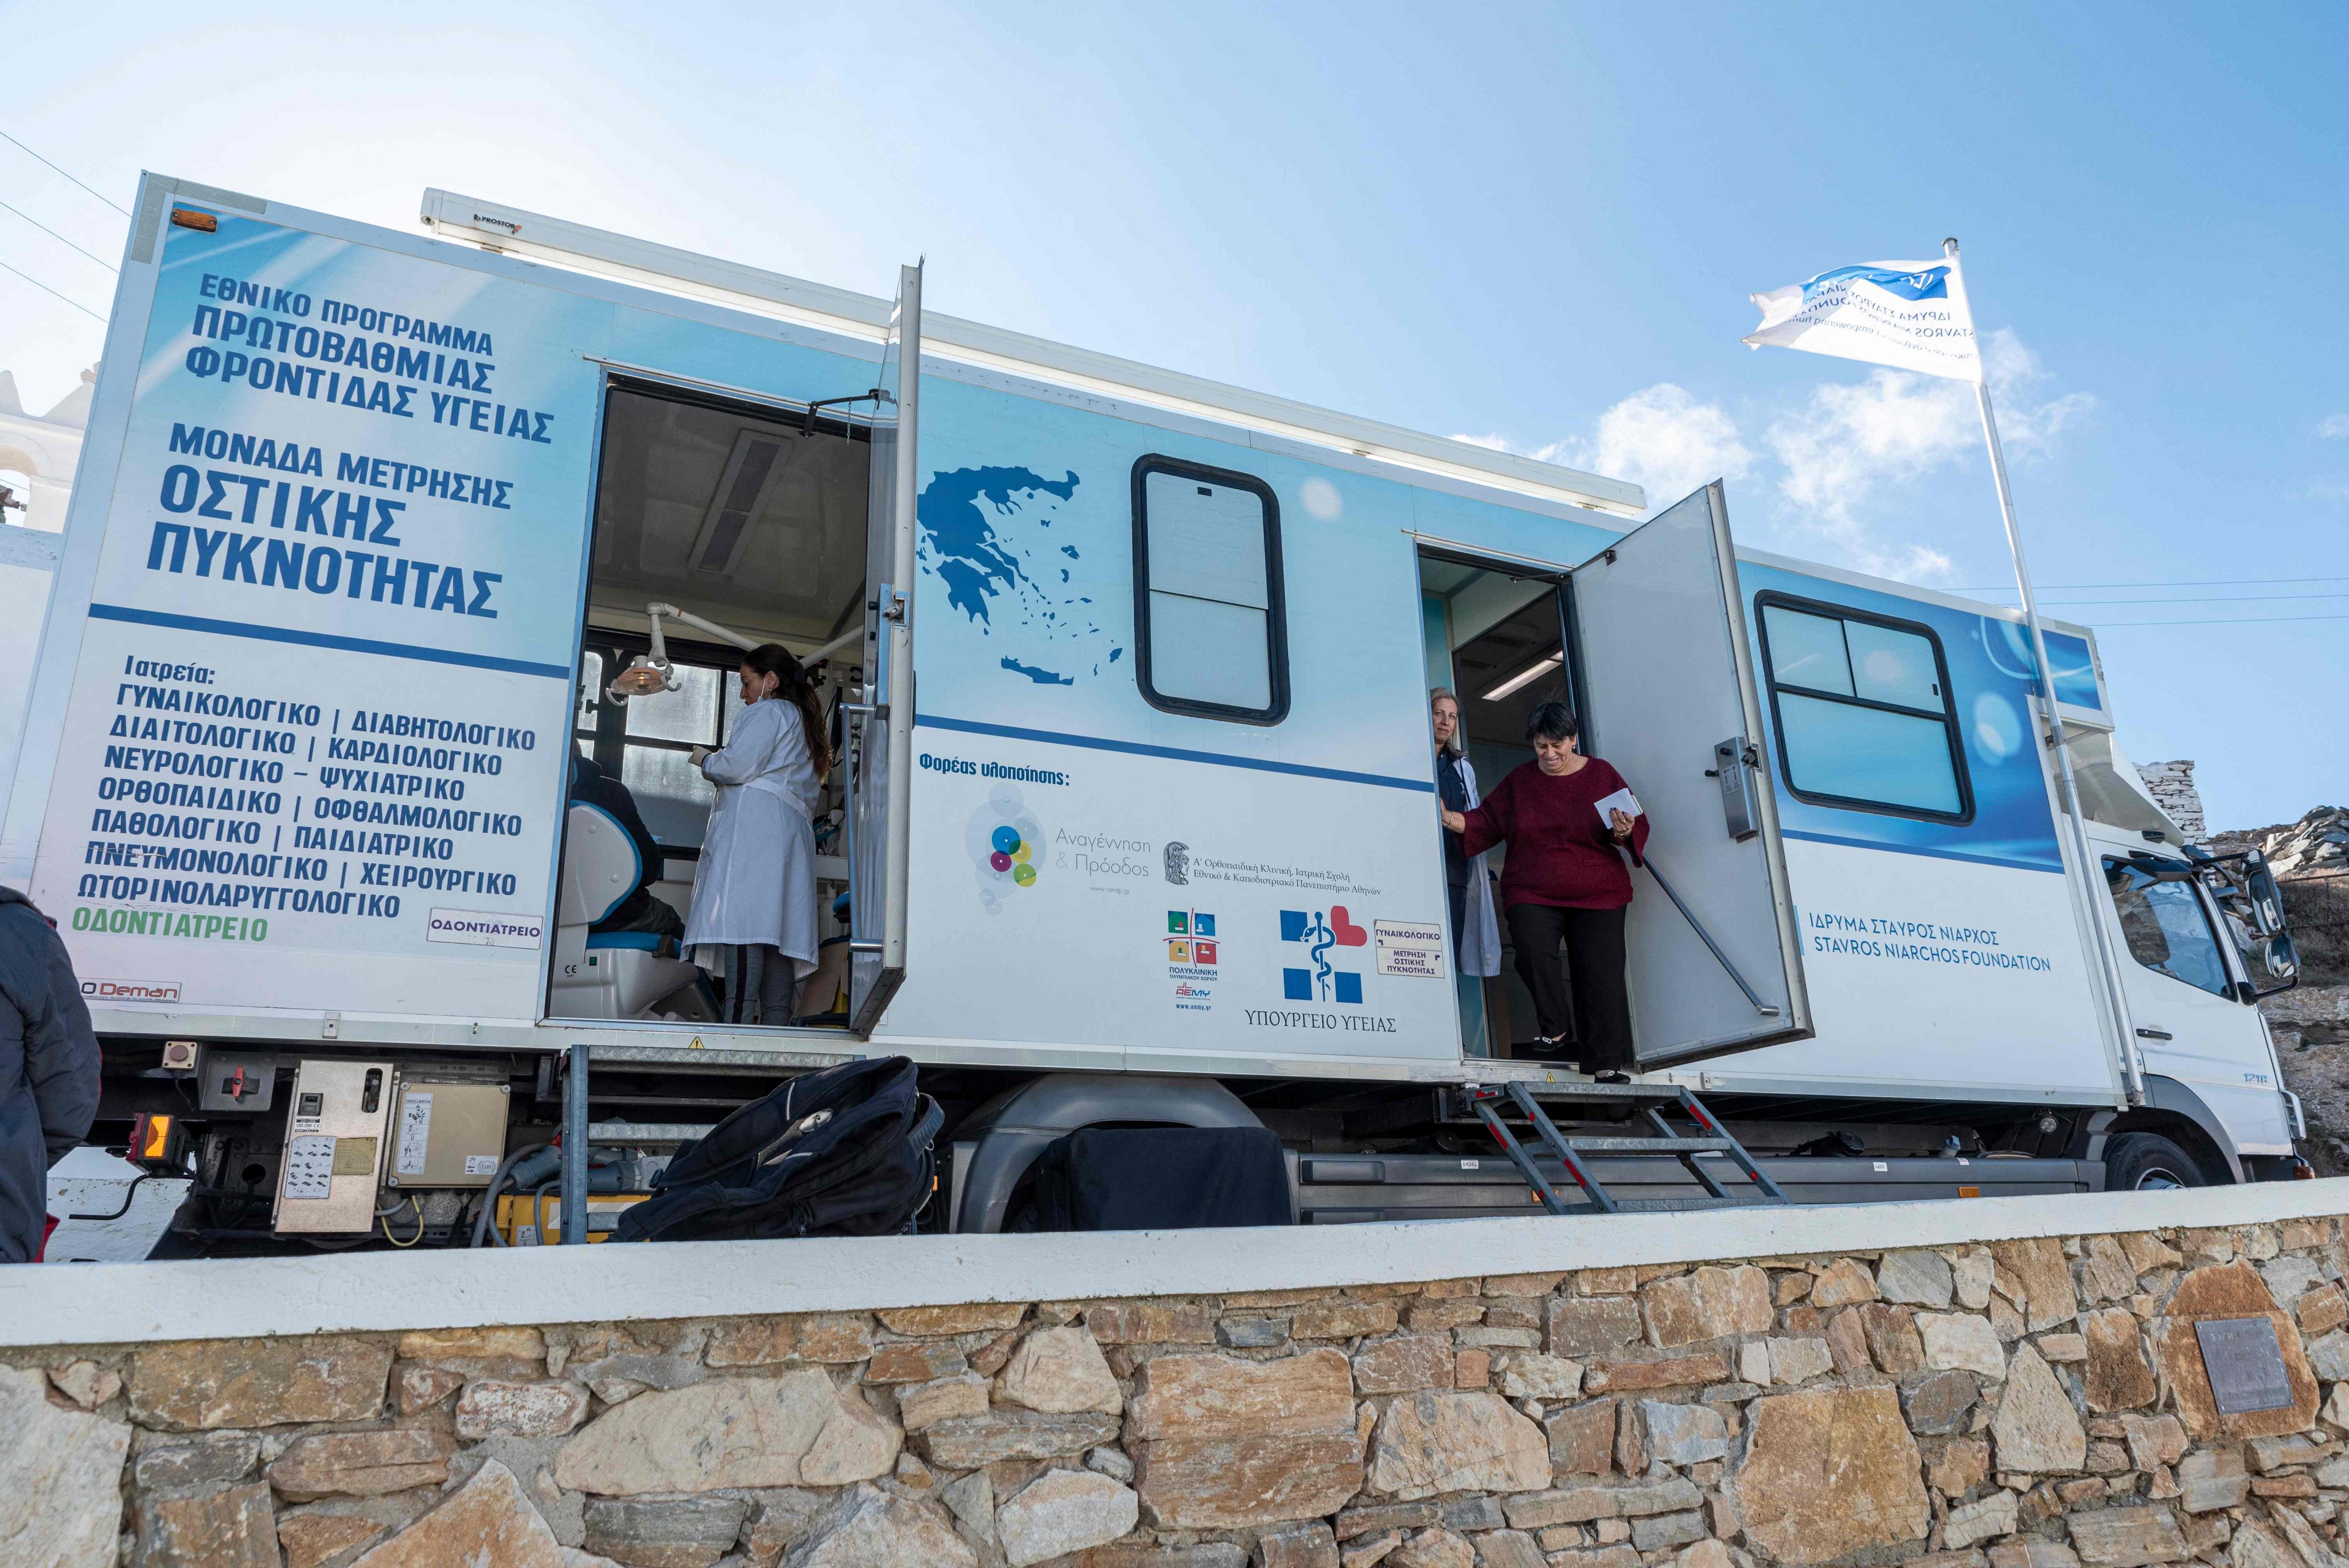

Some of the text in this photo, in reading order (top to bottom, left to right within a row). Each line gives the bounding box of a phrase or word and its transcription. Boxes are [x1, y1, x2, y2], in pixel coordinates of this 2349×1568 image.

[481, 216, 516, 229] PROSTOR
[200, 274, 493, 357] ΕΘΝΙΚΟ ΠΡΟΓΡΑΜΜΑ
[192, 304, 495, 394] ΠΡΩΤΟΒΑΘΜΙΑΣ
[185, 346, 555, 444] ΦΡΟΝΤΙΔΑΣ ΥΓΕΙΑΣ
[169, 422, 514, 510] ΜΟΝΑΔΑ ΜΕΤΡΗΣΗΣ
[159, 465, 407, 547] ΟΣΤΙΚΗΣ
[146, 521, 503, 619] ΠΥΚΝΟΤΗΤΑΣ
[124, 654, 215, 686] Ιατρεία:
[116, 683, 321, 727] ΓΥΝΑΙΚΟΛΟΓΙΚΟ
[350, 710, 536, 752] ΔΙΑΒΗΤΟΛΟΓΙΚΟ
[110, 714, 296, 755] ΔΙΑΙΤΟΛΟΓΙΚΟ
[327, 737, 502, 776] ΚΑΡΔΙΟΛΟΓΙΚΟ
[104, 745, 284, 784] ΝΕΥΡΟΛΟΓΙΚΟ
[319, 767, 465, 802] ΨΥΧΙΑΤΡΙΚΟ
[919, 752, 1070, 786] Φορέας υλοποίησης:
[98, 777, 281, 816] ΟΡΘΟΠΑΙΔΙΚΟ
[314, 796, 522, 837] ΟΦΘΑΛΜΟΛΟΓΙΚΟ
[91, 809, 261, 845] ΠΑΘΟΛΟΓΙΚΟ
[293, 826, 454, 860] ΠΑΙΔΙΑΤΡΙΚΟ
[1055, 828, 1150, 853] Αναγέννηση
[84, 841, 328, 882] ΠΝΕΥΜΟΝΟΛΟΓΙΚΟ
[360, 862, 517, 895] ΧΕΙΡΟΥΡΓΙΚΟ
[1056, 851, 1149, 876] & Πρόοδος
[1204, 859, 1258, 874] Ορθοπαιδική
[1260, 864, 1294, 877] Κλινική,
[1295, 867, 1325, 880] Ιατρική
[1326, 870, 1350, 883] Σχολή
[77, 873, 401, 918] ΩΤΟΡΙΝΟΛΑΡΥΓΓΟΛΟΓΙΚΟ
[1090, 885, 1130, 895] www.randp.gr
[1193, 869, 1381, 895] Εθνικό & Καποδιστριακό Πανεπιστήμιο Αθηνών
[71, 906, 269, 942] ΟΔΟΝΤΙΑΤΡΕΙΟ
[430, 918, 541, 939] ΟΔΟΝΤΙΑΤΡΕΙΟ
[1376, 929, 1440, 940] ΓΥΝΑΙΚΟΛΟΓΙΚΟ
[1809, 912, 1999, 946] ΙΔΡΥΜΑ ΣΤΑΥΡΟΣ ΝΙΑΡΧΟΣ
[1169, 966, 1217, 976] ΠΟΛΥΚΛΙΝΙΚΗ
[1387, 965, 1435, 974] ΠΥΚΝΟΤΗΤΑΣ
[1394, 958, 1425, 966] ΟΣΤΙΚΗΣ
[1814, 937, 2051, 972] STAVROS NIARCHOS FOUNDATION
[99, 982, 177, 998] Deman
[1244, 1009, 1397, 1033] ΥΠΟΥΡΓΕΙΟ ΥΓΕΙΑΣ
